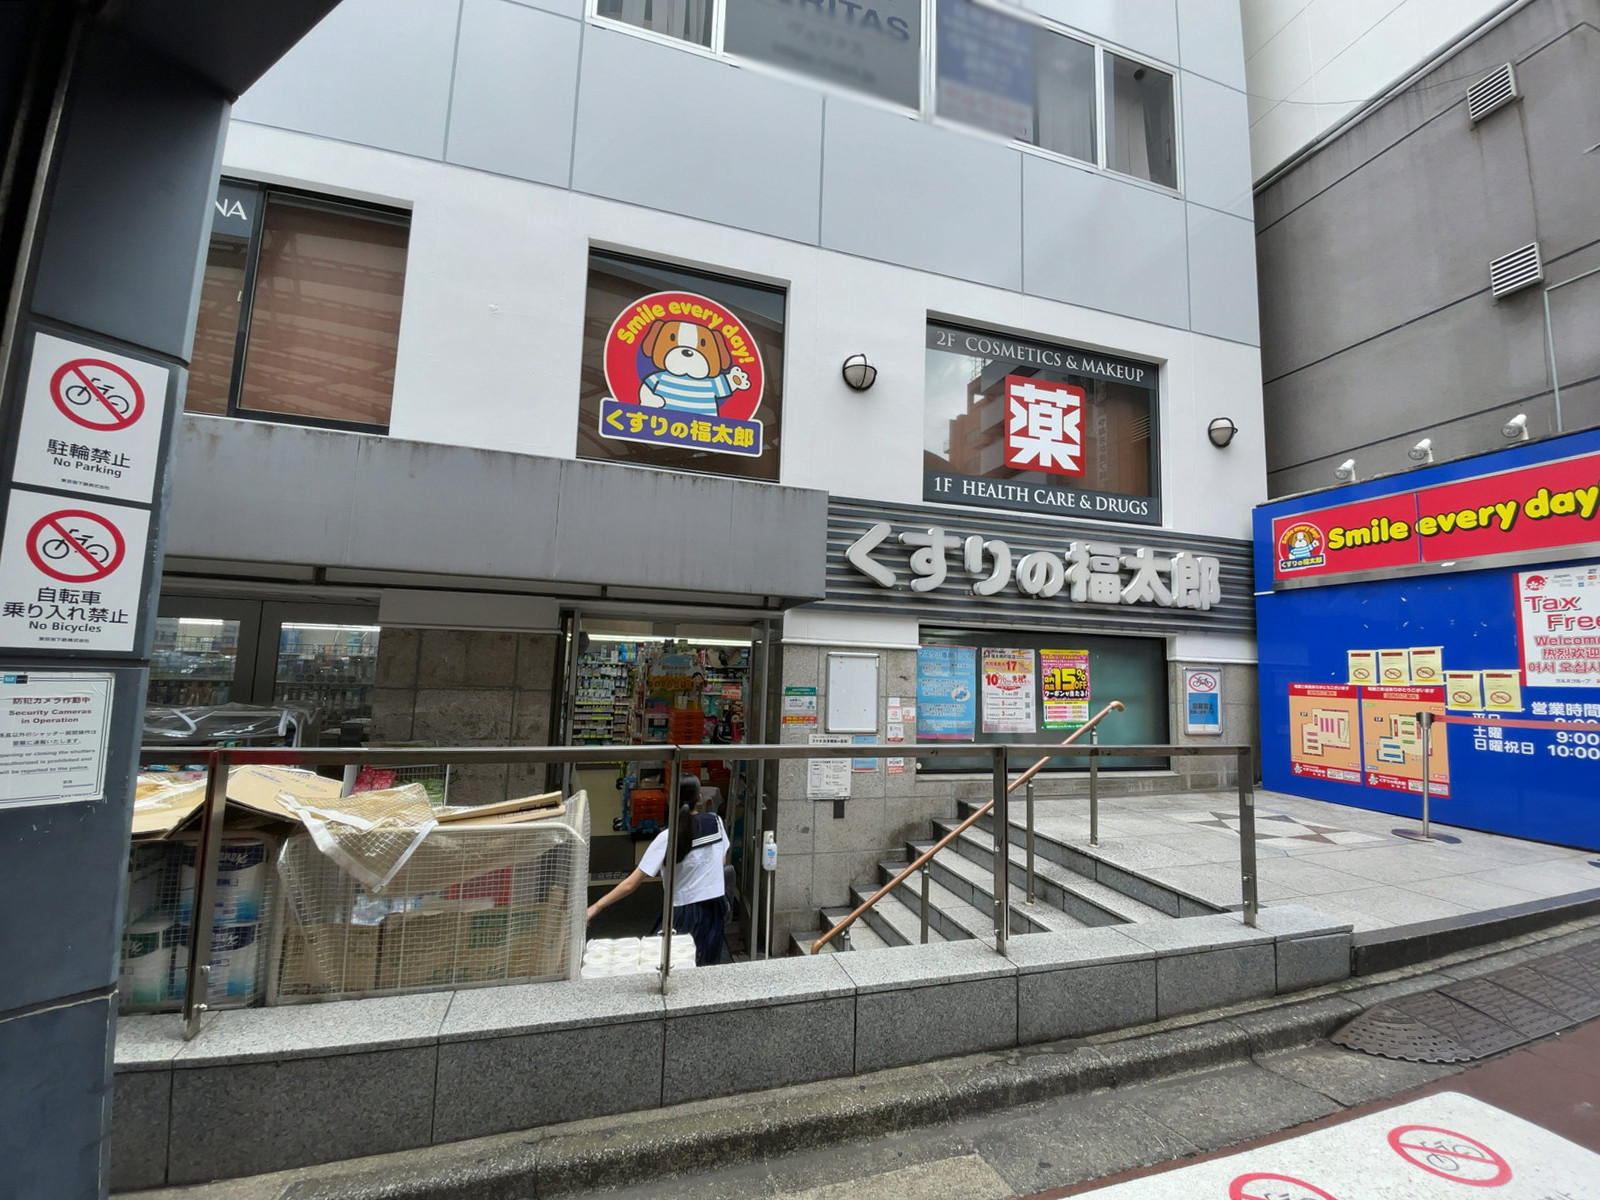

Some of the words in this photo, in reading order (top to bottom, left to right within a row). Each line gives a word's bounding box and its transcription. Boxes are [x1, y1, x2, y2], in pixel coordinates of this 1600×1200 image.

[617, 304, 666, 345] Smile
[668, 302, 724, 329] every
[722, 324, 755, 363] day!
[936, 331, 956, 348] 2F
[965, 336, 1062, 367] COSMETICS
[1066, 355, 1078, 370] &
[1082, 358, 1145, 382] MAKEUP
[606, 409, 754, 448] くすりの福太郎
[1010, 382, 1081, 472] 薬
[47, 439, 131, 469] 駐輪禁止
[53, 457, 71, 468] No
[75, 461, 122, 479] Parking
[934, 476, 953, 494] 1F
[962, 480, 1030, 503] HEALTH
[1034, 488, 1076, 508] CARE
[1079, 494, 1092, 510] &
[1096, 496, 1148, 516] DRUGS
[1328, 517, 1411, 551] Smile
[1415, 499, 1520, 537] every
[845, 522, 1221, 611] くすりの福太郎
[37, 587, 102, 606] 自転車
[1524, 595, 1582, 613] Tax
[2, 601, 129, 624] 乗り入れ禁止
[29, 621, 47, 630] No
[52, 622, 102, 634] Bicycles
[1535, 635, 1600, 646] Welcom
[9, 709, 49, 717] Security
[1531, 701, 1600, 718] 営業時間
[1473, 725, 1503, 740] 土曜
[1556, 731, 1600, 746] 9:00
[1474, 738, 1535, 755] 日曜祝日
[1547, 744, 1600, 760] 10:00
